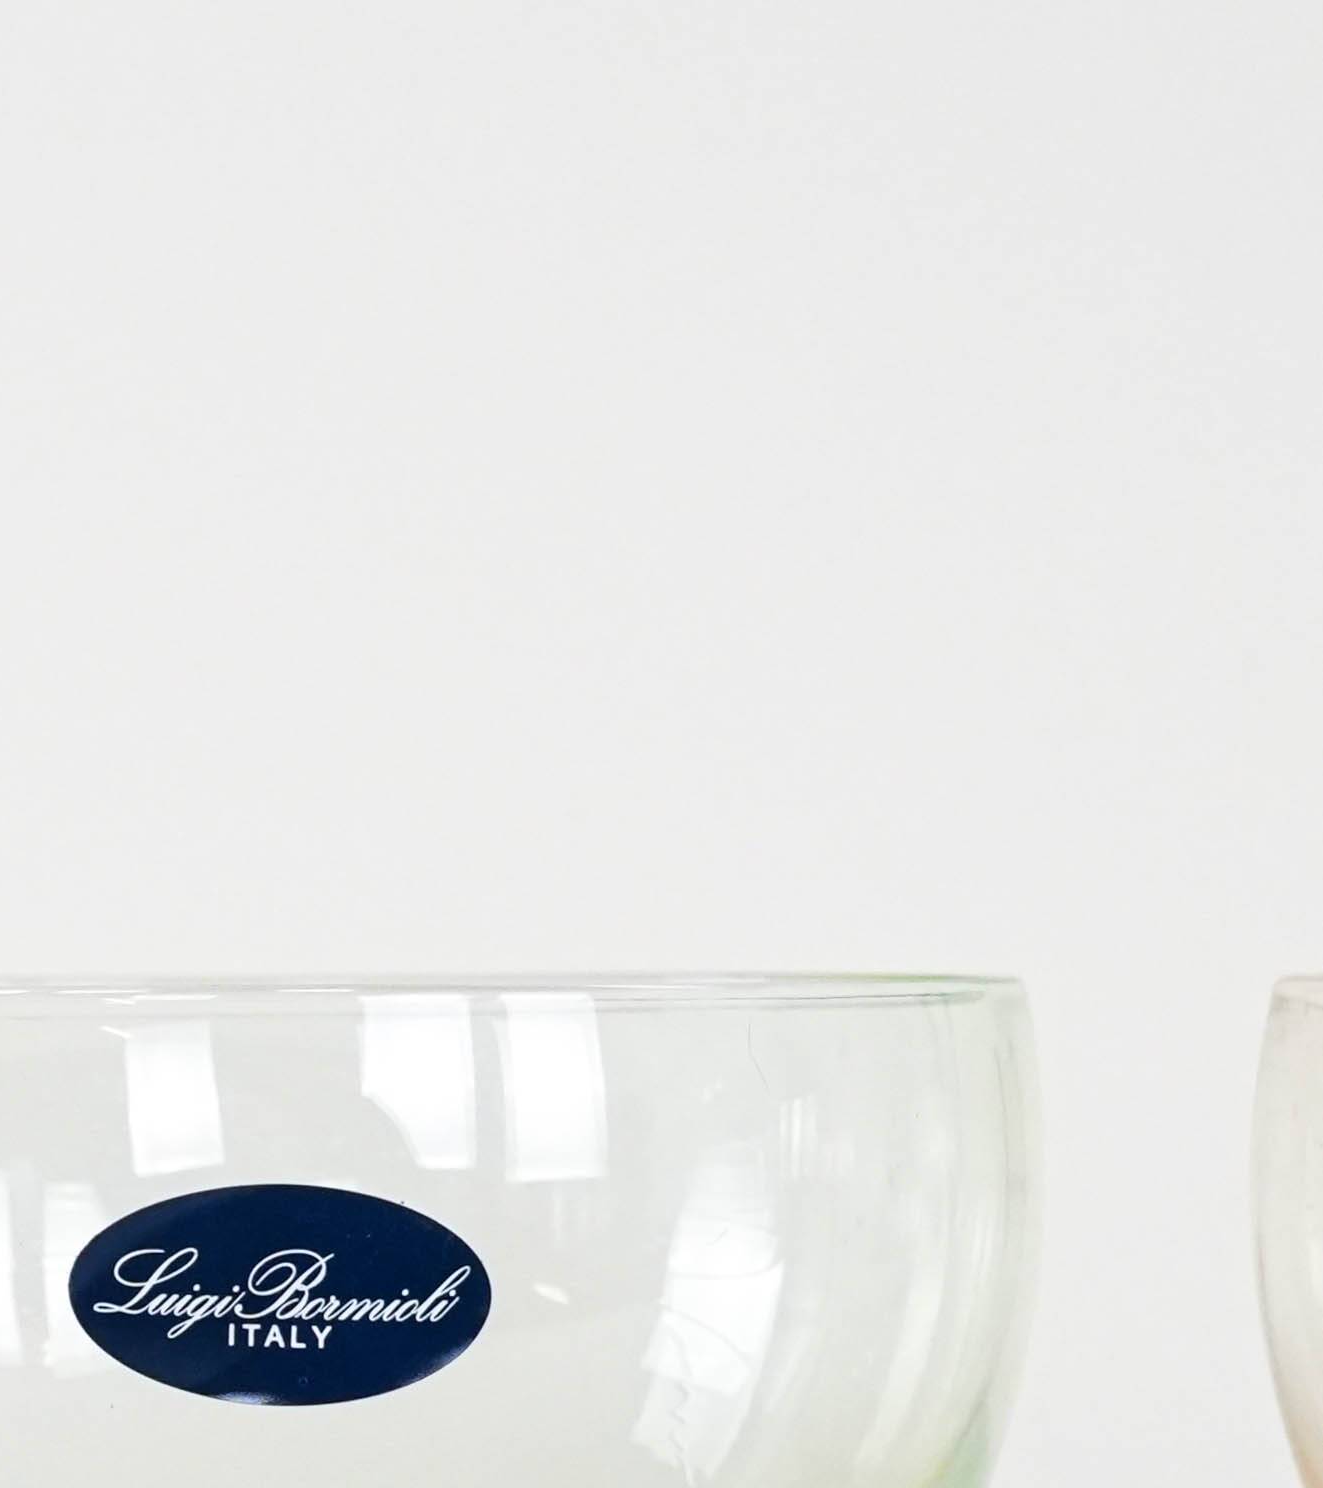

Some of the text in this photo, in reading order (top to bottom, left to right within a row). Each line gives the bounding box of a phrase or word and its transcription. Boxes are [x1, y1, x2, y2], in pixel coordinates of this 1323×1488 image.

[93, 1247, 471, 1338] Luigi Bormioli
[227, 1322, 333, 1349] ITALY
